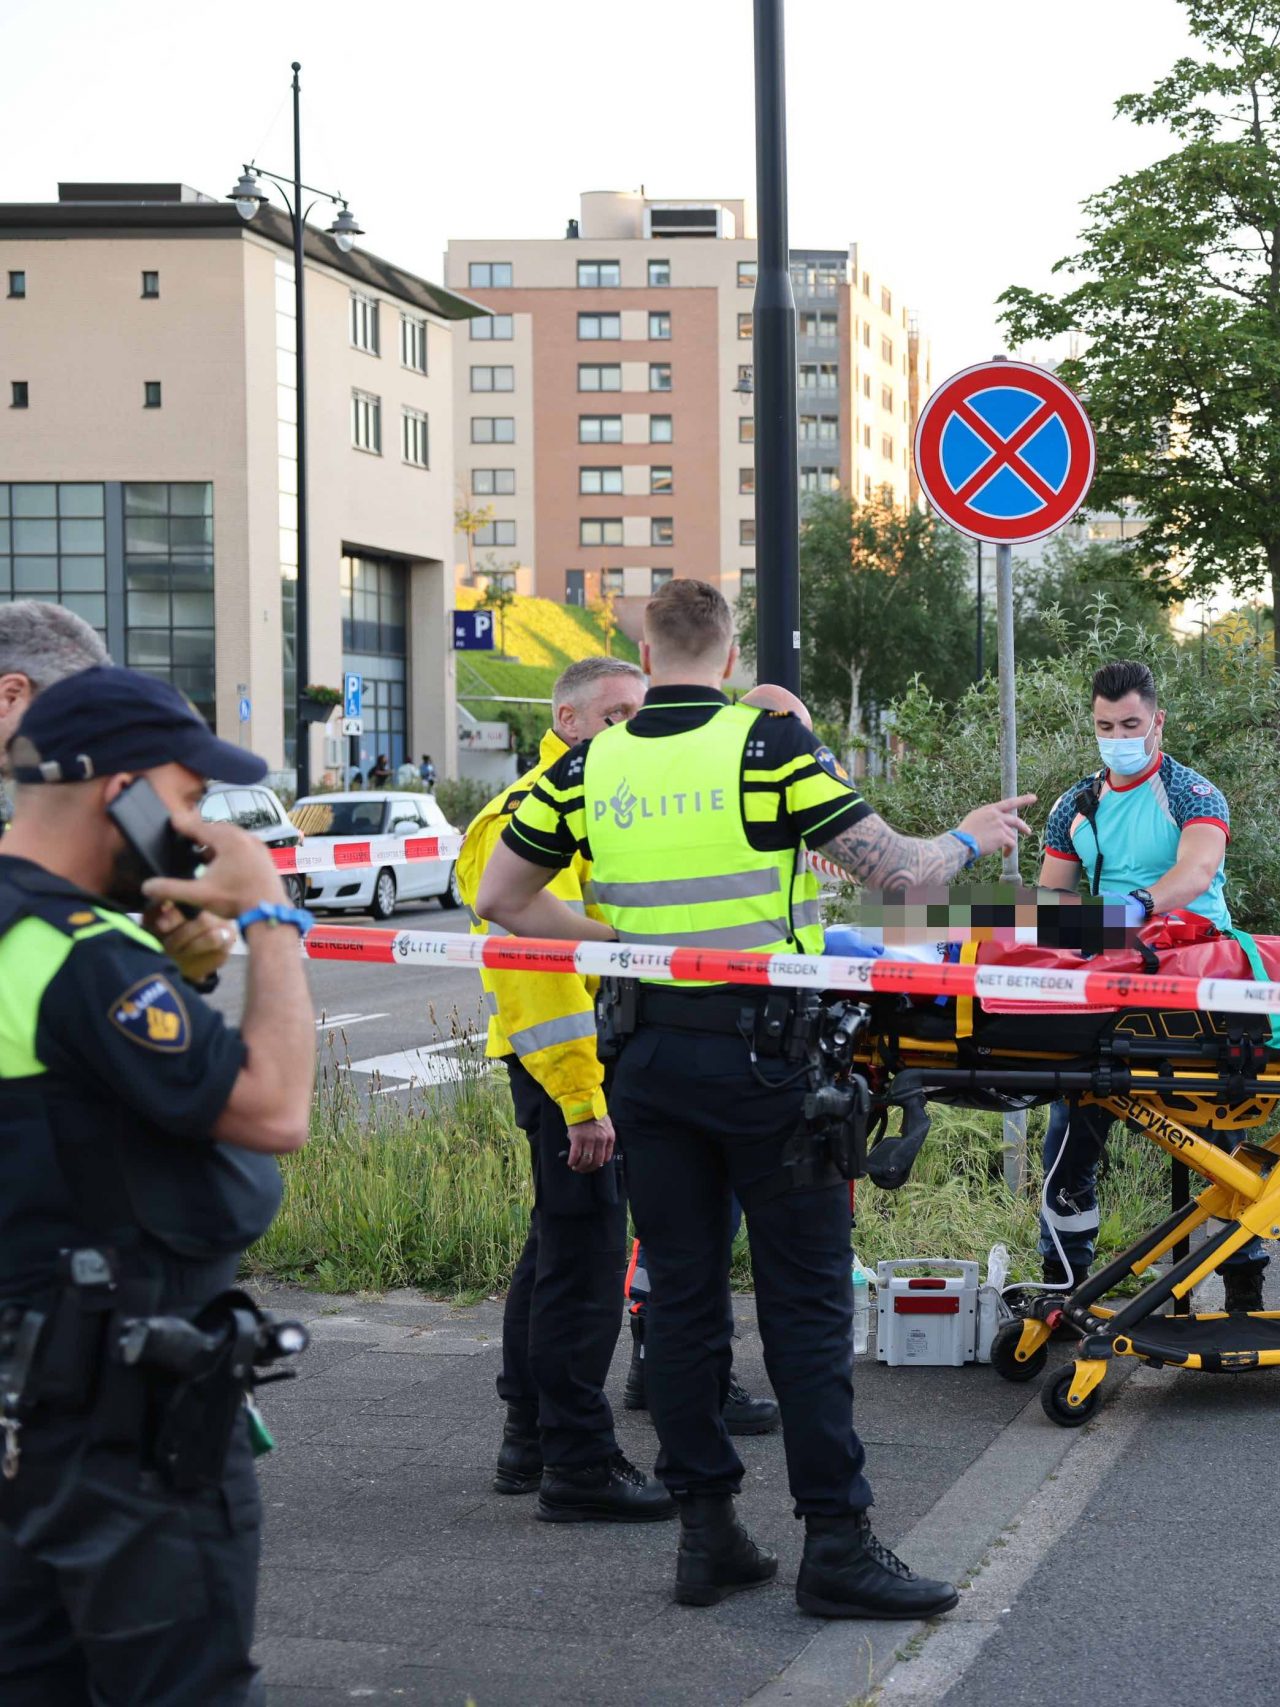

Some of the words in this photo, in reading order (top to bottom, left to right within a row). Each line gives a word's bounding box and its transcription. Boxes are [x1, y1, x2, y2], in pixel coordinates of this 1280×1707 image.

[475, 615, 491, 639] P
[348, 676, 358, 700] P
[594, 777, 724, 829] POLITIE
[310, 938, 363, 951] BETREDEN
[390, 935, 447, 956] POLITIE
[499, 947, 521, 960] NIET
[525, 948, 582, 963] BETREDEN
[610, 948, 671, 968] POLITIE
[727, 959, 753, 971] NIET
[756, 961, 818, 975] BETREDEN
[976, 974, 1002, 986] NIET
[1006, 975, 1073, 990] BETREDEN
[1244, 988, 1274, 1002] NIET
